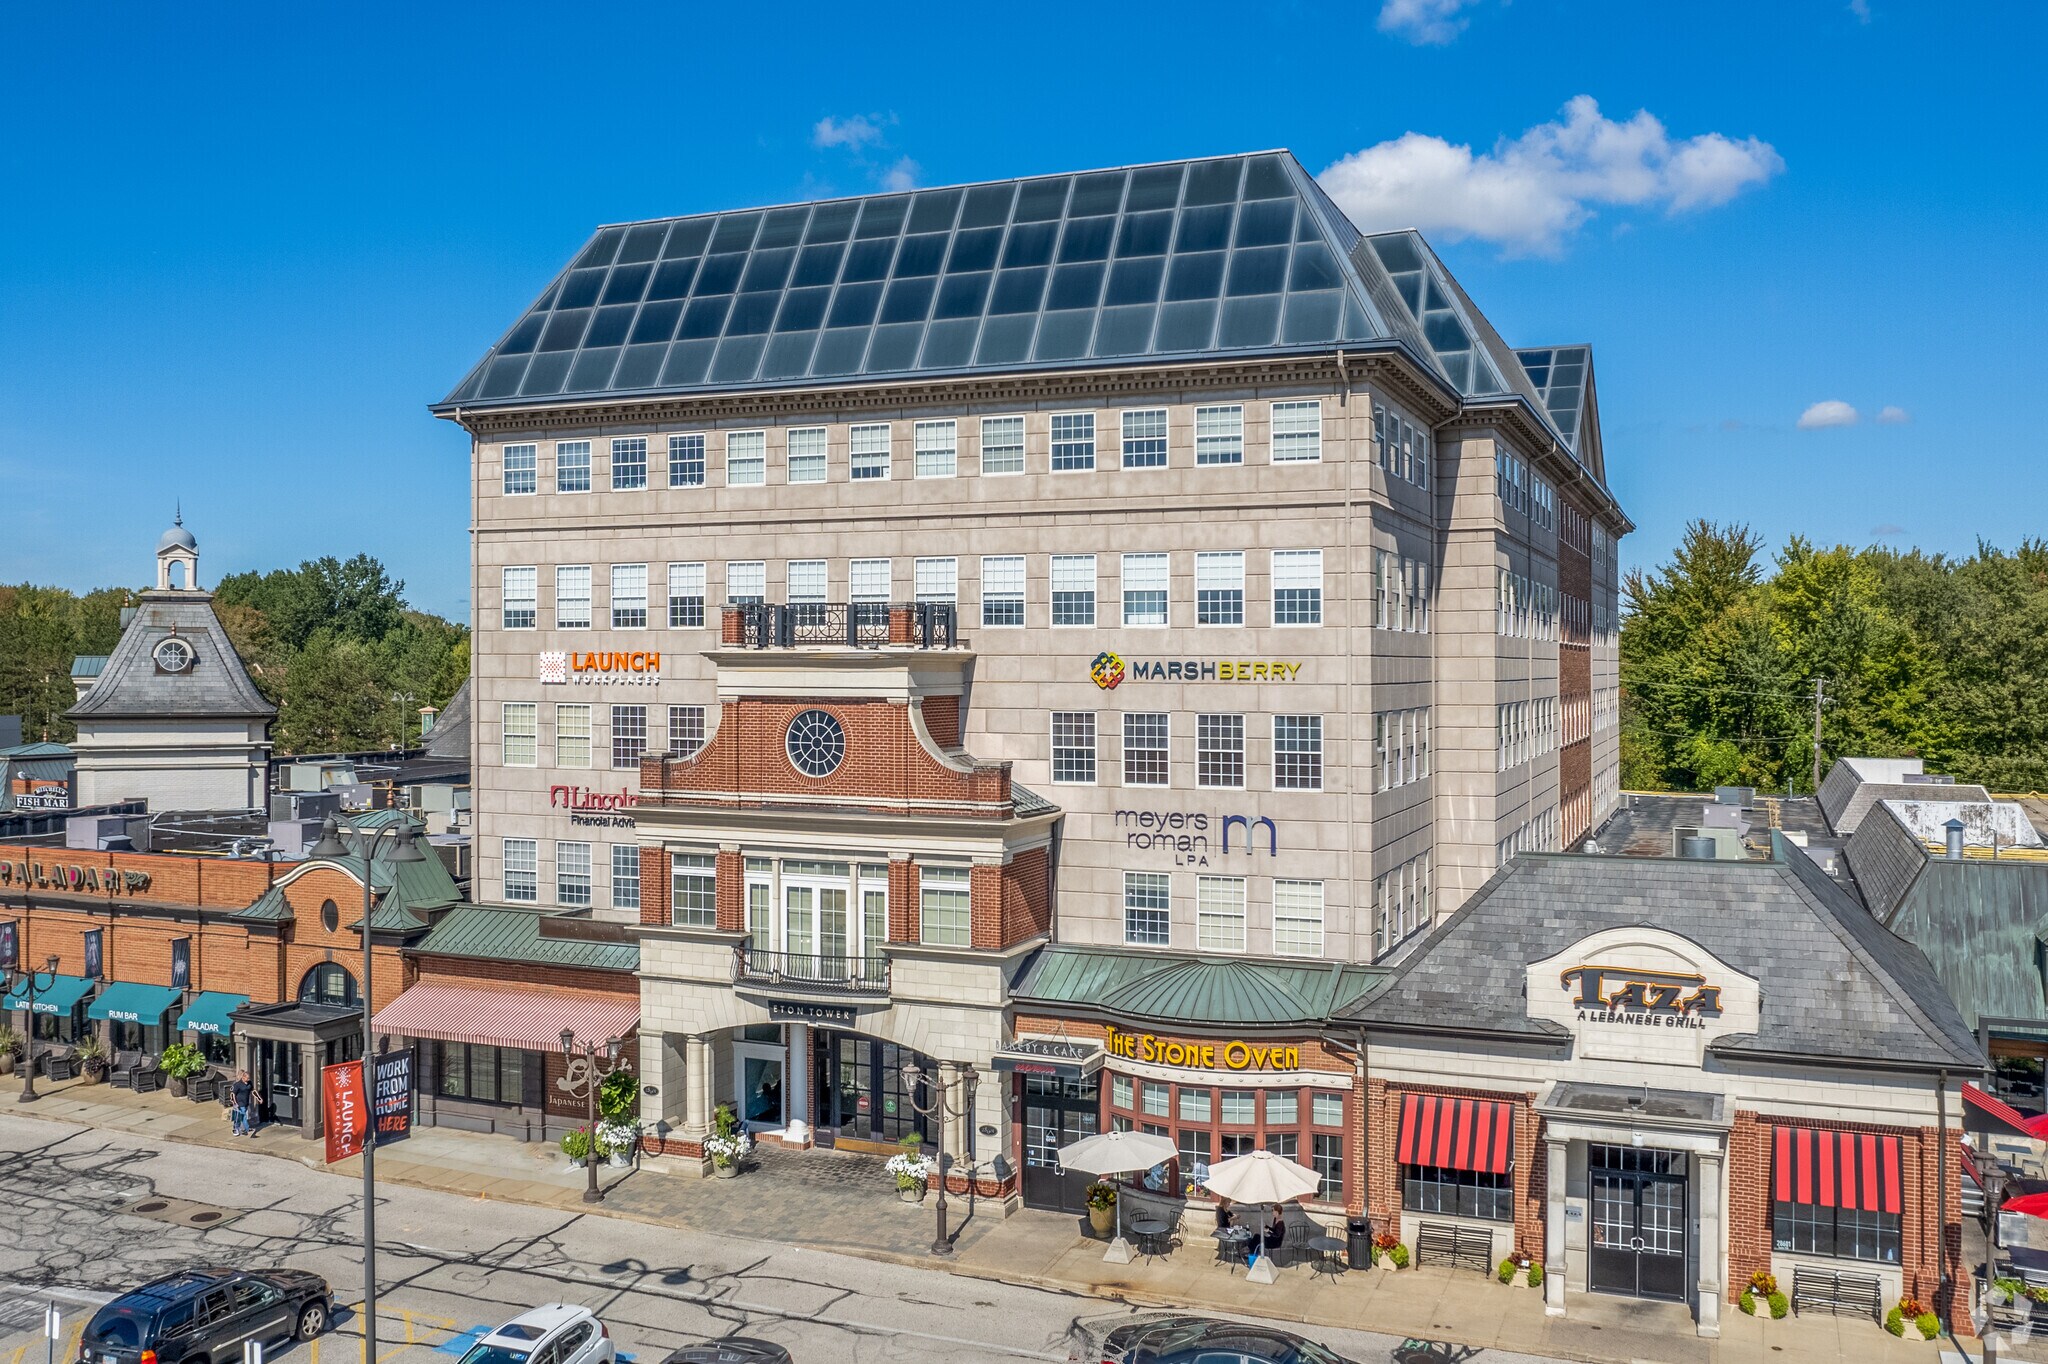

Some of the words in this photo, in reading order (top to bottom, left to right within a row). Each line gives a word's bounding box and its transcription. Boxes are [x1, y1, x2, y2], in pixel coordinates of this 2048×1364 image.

[571, 652, 660, 672] LAUNCH
[1133, 661, 1302, 681] MARSHBERRY
[571, 674, 661, 686] WORKPLACES
[17, 797, 40, 807] FISH
[571, 815, 610, 828] Financial
[1115, 810, 1208, 832] meyers
[1127, 832, 1208, 852] roman
[1175, 854, 1209, 867] LPA
[0, 860, 119, 890] PALADAR
[32, 1003, 59, 1012] KITCHEN
[109, 1010, 124, 1019] RUM
[124, 1012, 138, 1021] BAR
[773, 1004, 804, 1016] ETON
[808, 1007, 850, 1020] TOWER
[188, 1020, 219, 1031] PALADAR
[1578, 1010, 1586, 1021] A
[1590, 1011, 1662, 1027] LEBANESE
[1665, 1015, 1706, 1029] GRILL
[1042, 1044, 1049, 1055] &
[377, 1057, 409, 1081] WORK
[376, 1075, 408, 1097] FROM
[376, 1093, 408, 1116] HOME
[341, 1090, 354, 1156] LAUNCH
[378, 1115, 408, 1132] HERE
